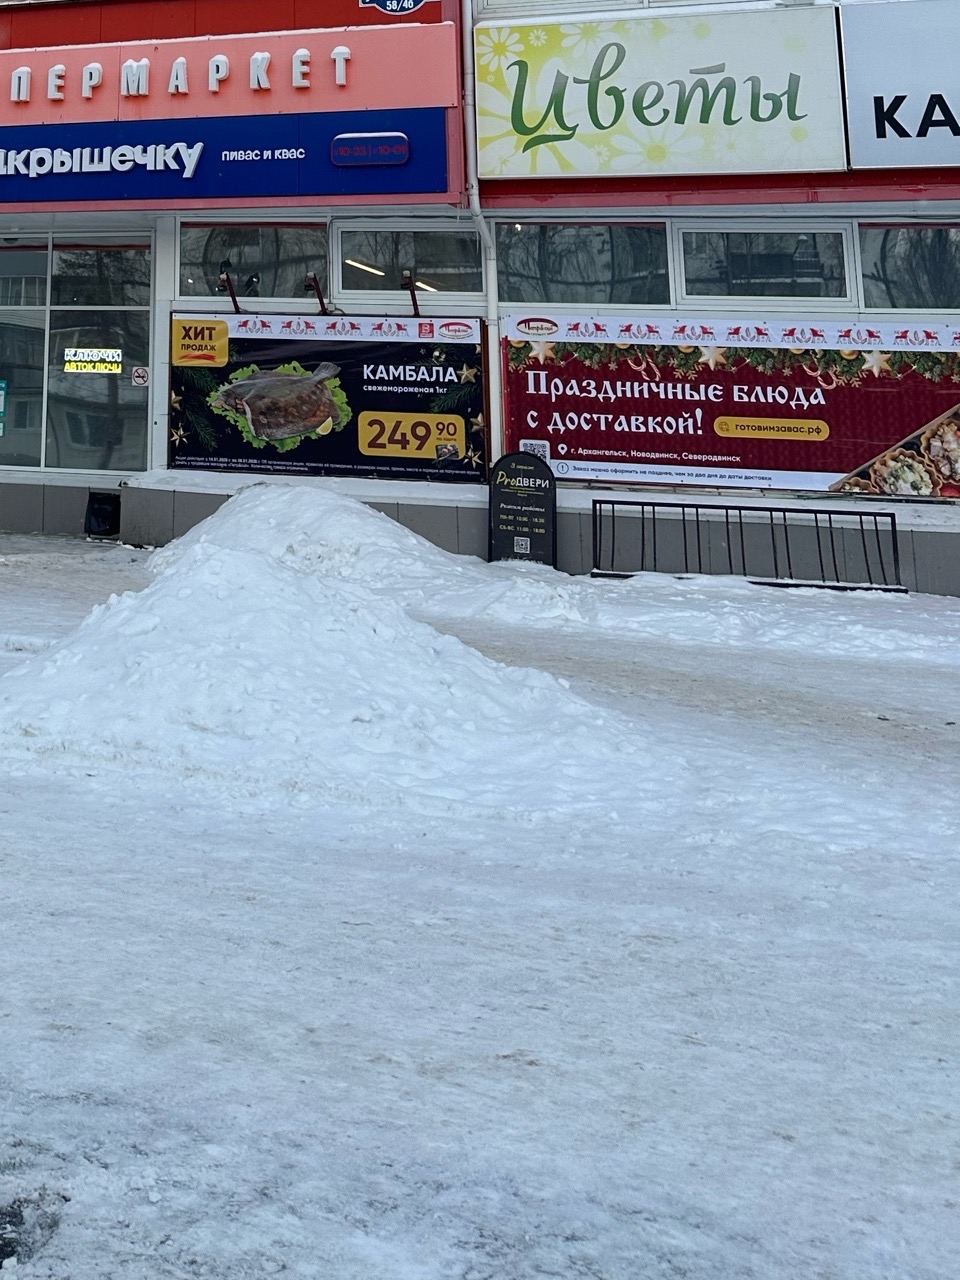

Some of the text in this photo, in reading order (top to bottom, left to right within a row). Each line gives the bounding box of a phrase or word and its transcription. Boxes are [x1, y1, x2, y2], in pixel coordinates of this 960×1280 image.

[386, 0, 414, 11] 58/46
[506, 42, 808, 154] Цветы
[874, 94, 960, 139] КА
[221, 148, 305, 161] пивас и квас
[181, 326, 216, 341] ХИТ
[181, 344, 216, 352] ПРОДАЖ
[65, 350, 121, 361] КЛЮЧИ
[64, 363, 121, 371] АВТОКЛЮЧИ
[363, 365, 458, 383] КАМБАЛА
[363, 385, 448, 394] свежемороженая 1кг
[525, 370, 826, 410] Праздничные блюда
[527, 407, 703, 435] с доставкой!
[367, 419, 458, 451] 249 90
[735, 424, 822, 435] готовимзавас.рф
[578, 448, 629, 458] Архангельск,
[631, 450, 681, 460] Новодвинск,
[682, 452, 741, 462] Северодвинск
